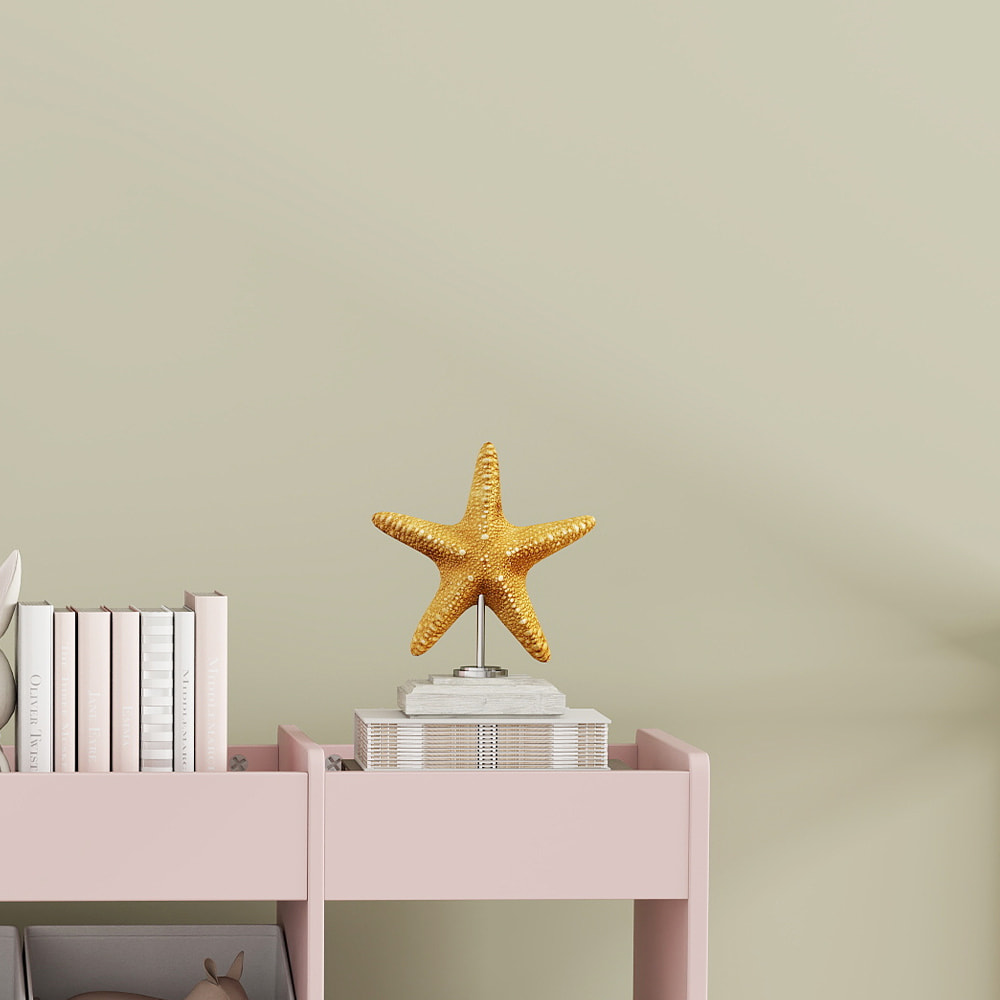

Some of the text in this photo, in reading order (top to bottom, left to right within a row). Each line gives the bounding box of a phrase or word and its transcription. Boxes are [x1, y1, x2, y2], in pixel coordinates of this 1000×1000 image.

[29, 674, 42, 771] OLIVER TWIST
[87, 690, 101, 719] JANE
